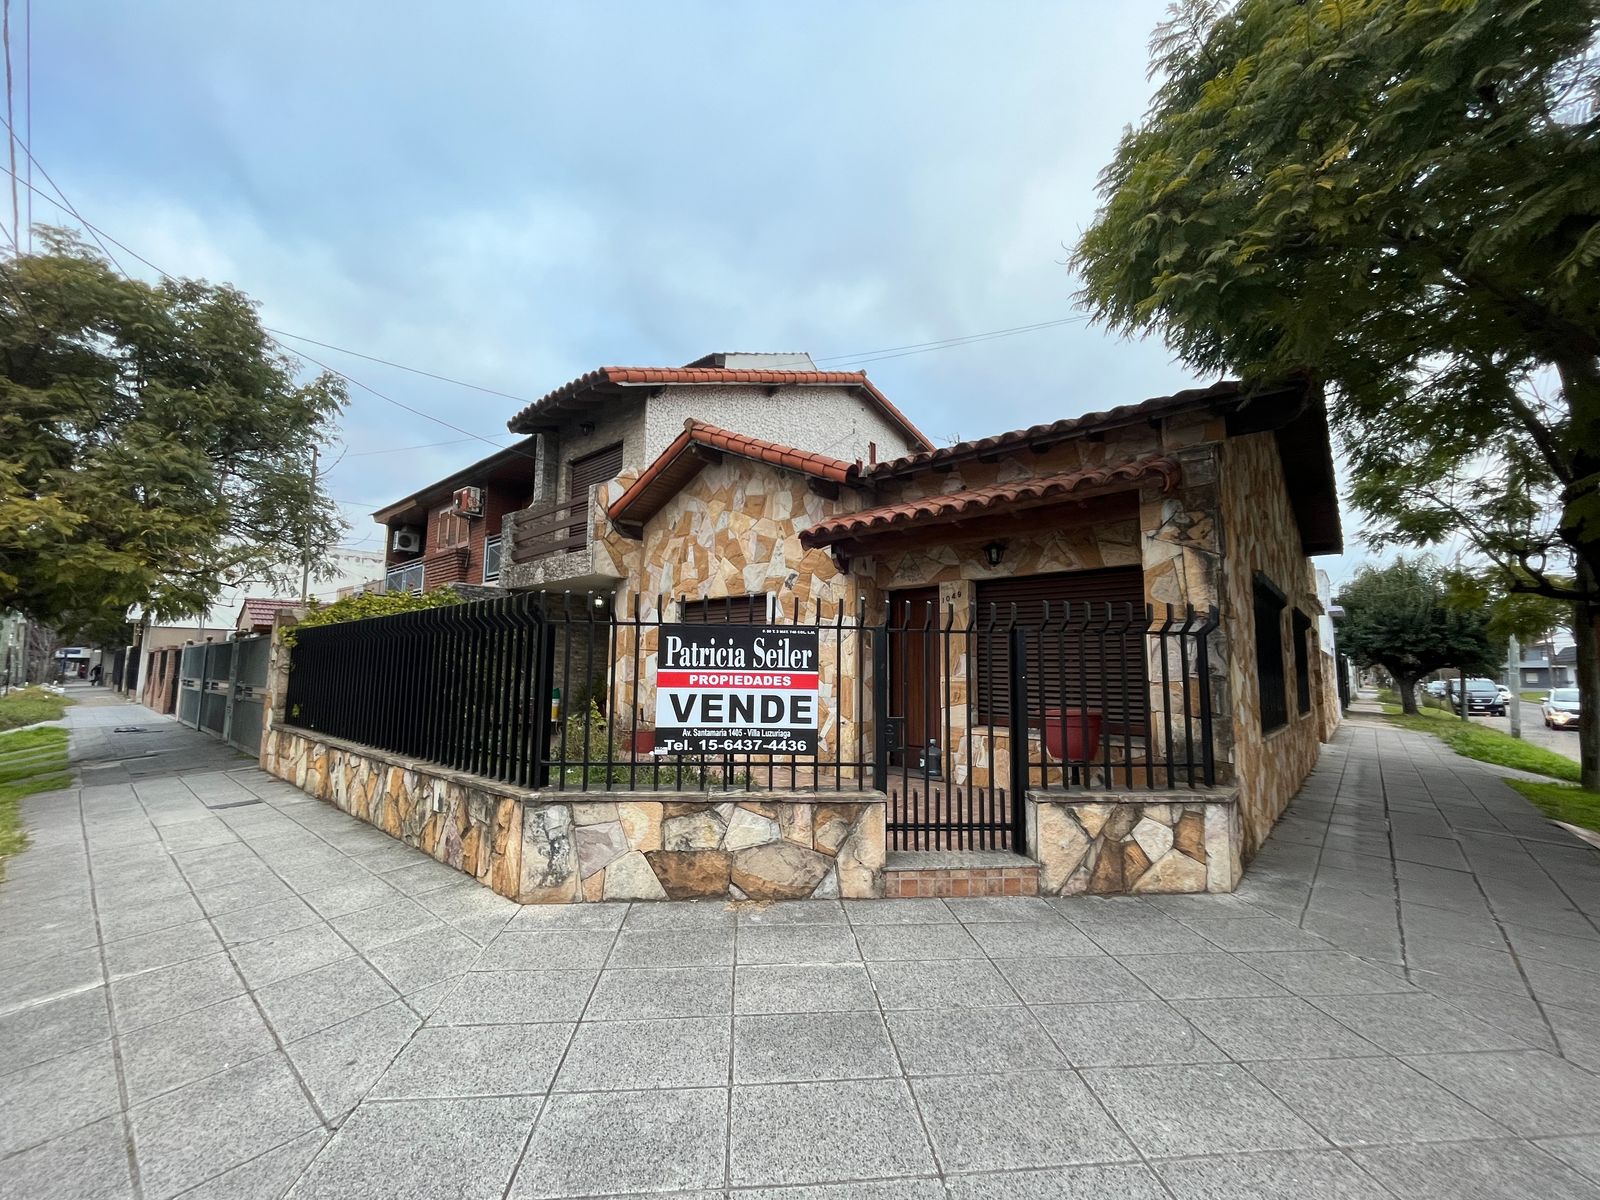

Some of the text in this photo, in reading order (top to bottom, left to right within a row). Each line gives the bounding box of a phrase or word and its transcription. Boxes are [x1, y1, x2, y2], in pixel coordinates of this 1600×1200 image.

[665, 635, 813, 669] Patricia Seiler
[689, 674, 792, 686] PROPIEDADES
[669, 693, 812, 724] VENDE
[682, 728, 691, 737] Av.
[747, 729, 760, 737] Villa
[761, 729, 791, 739] Luzuriaga
[664, 739, 693, 751] Tel.
[699, 739, 807, 752] 15-6437-4436
